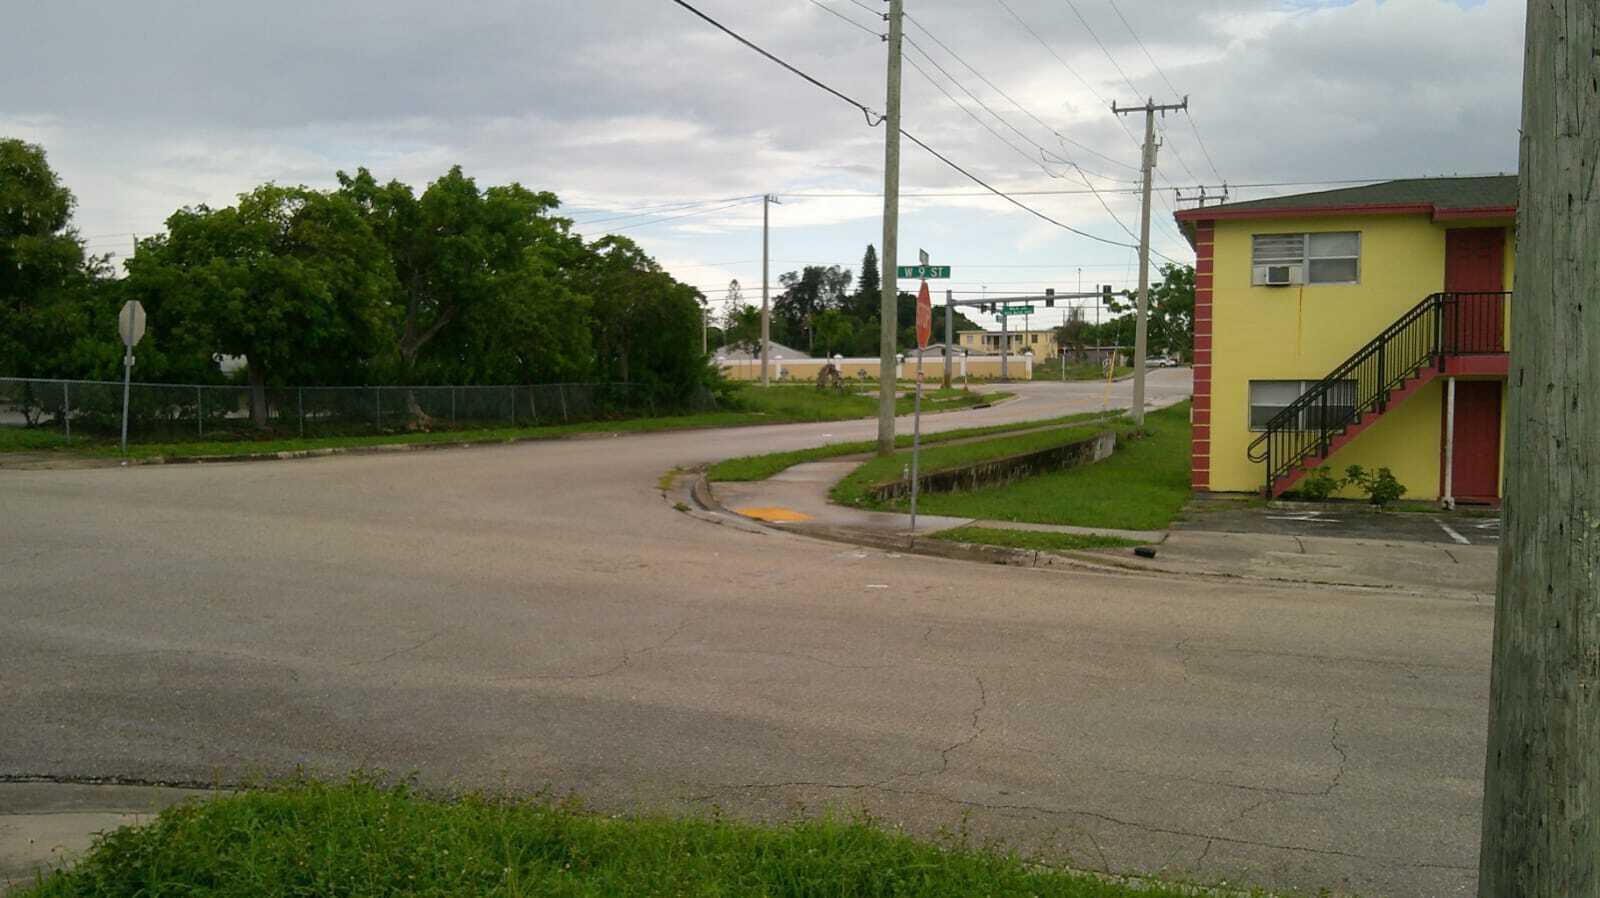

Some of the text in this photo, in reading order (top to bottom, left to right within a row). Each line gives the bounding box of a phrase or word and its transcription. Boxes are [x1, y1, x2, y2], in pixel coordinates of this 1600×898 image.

[904, 267, 943, 278] W 9 ST
